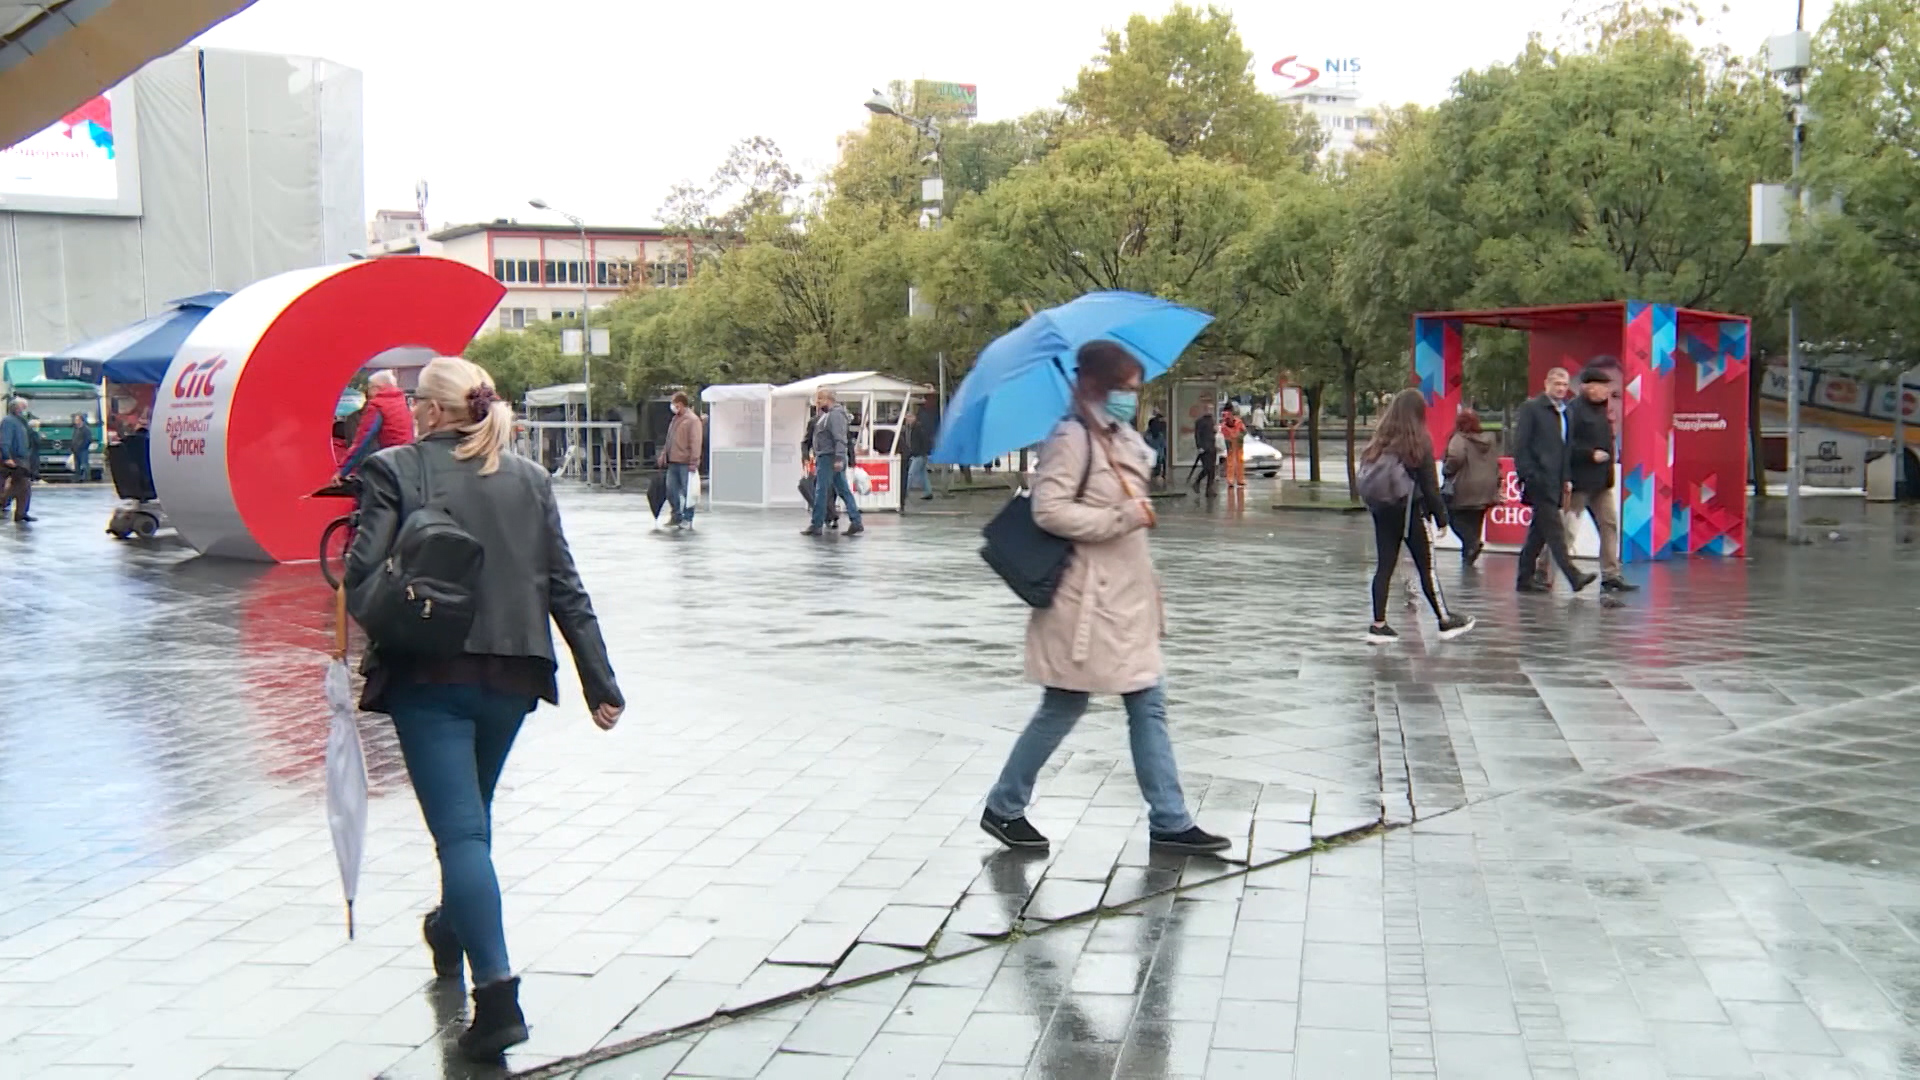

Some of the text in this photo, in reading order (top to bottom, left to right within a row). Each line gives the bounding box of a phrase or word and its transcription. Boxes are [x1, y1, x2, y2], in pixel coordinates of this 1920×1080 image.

[1325, 58, 1361, 73] NIS
[169, 434, 206, 461] Српске
[1490, 505, 1533, 526] СНС
